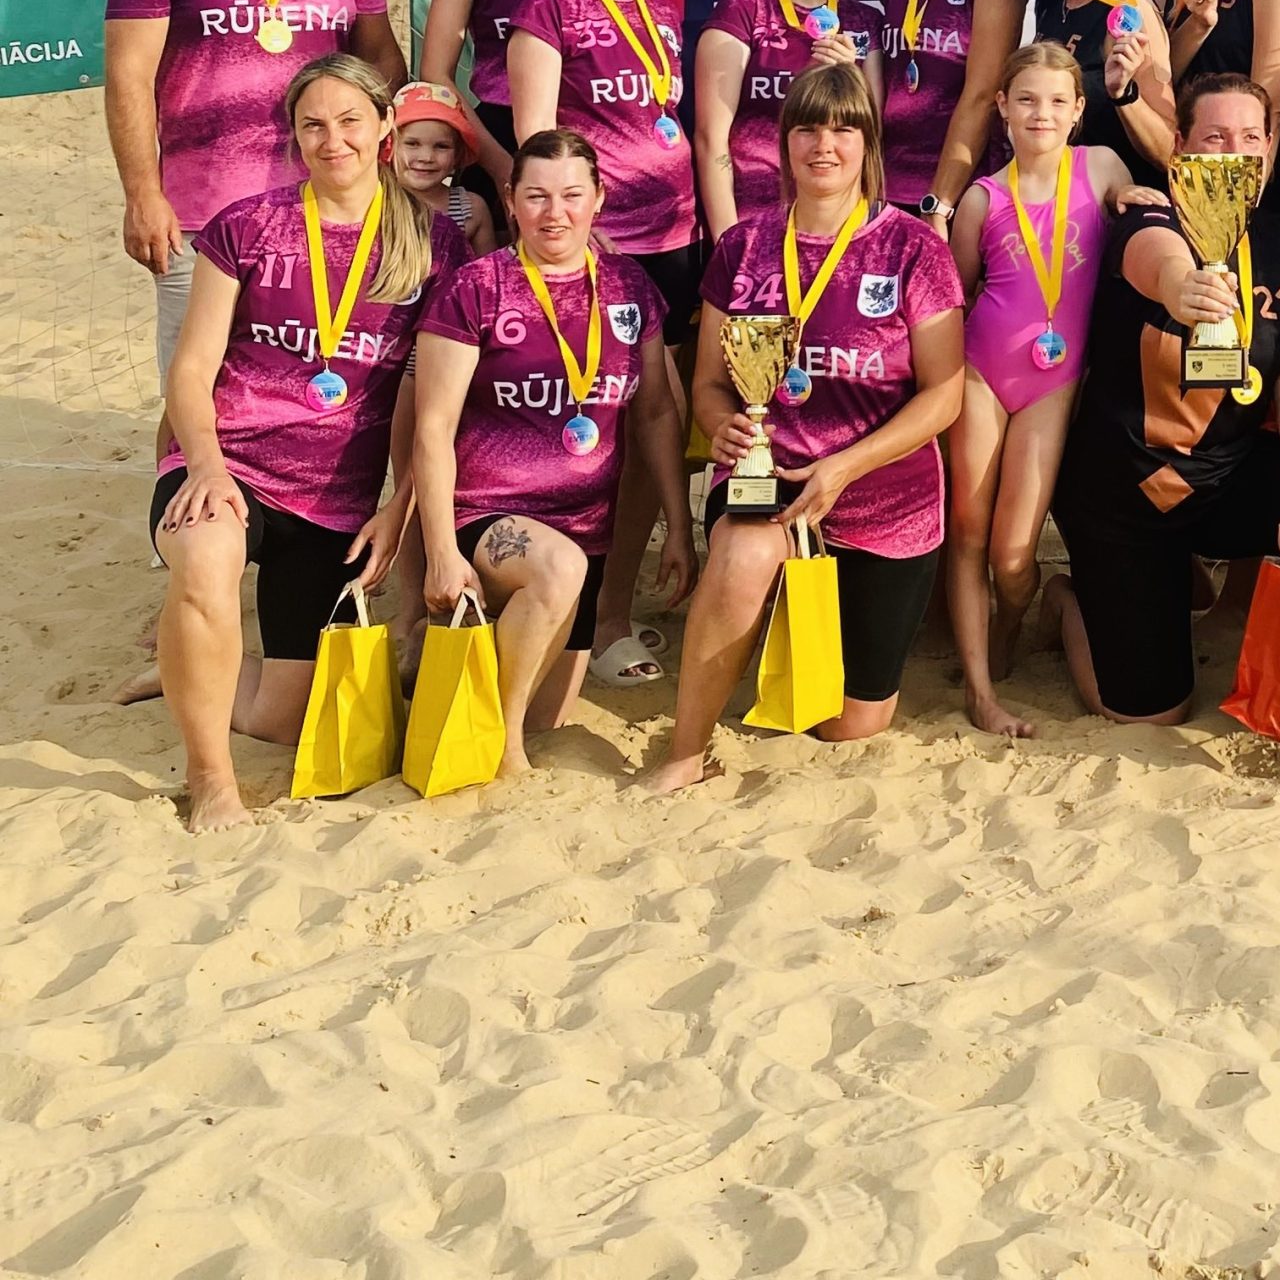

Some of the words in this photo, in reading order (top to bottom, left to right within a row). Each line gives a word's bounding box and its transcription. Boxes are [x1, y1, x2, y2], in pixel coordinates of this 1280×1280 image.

[573, 20, 618, 49] 33
[259, 253, 299, 289] 11
[728, 273, 783, 310] 24
[251, 320, 400, 363] RŪJENA
[495, 309, 527, 345] 6
